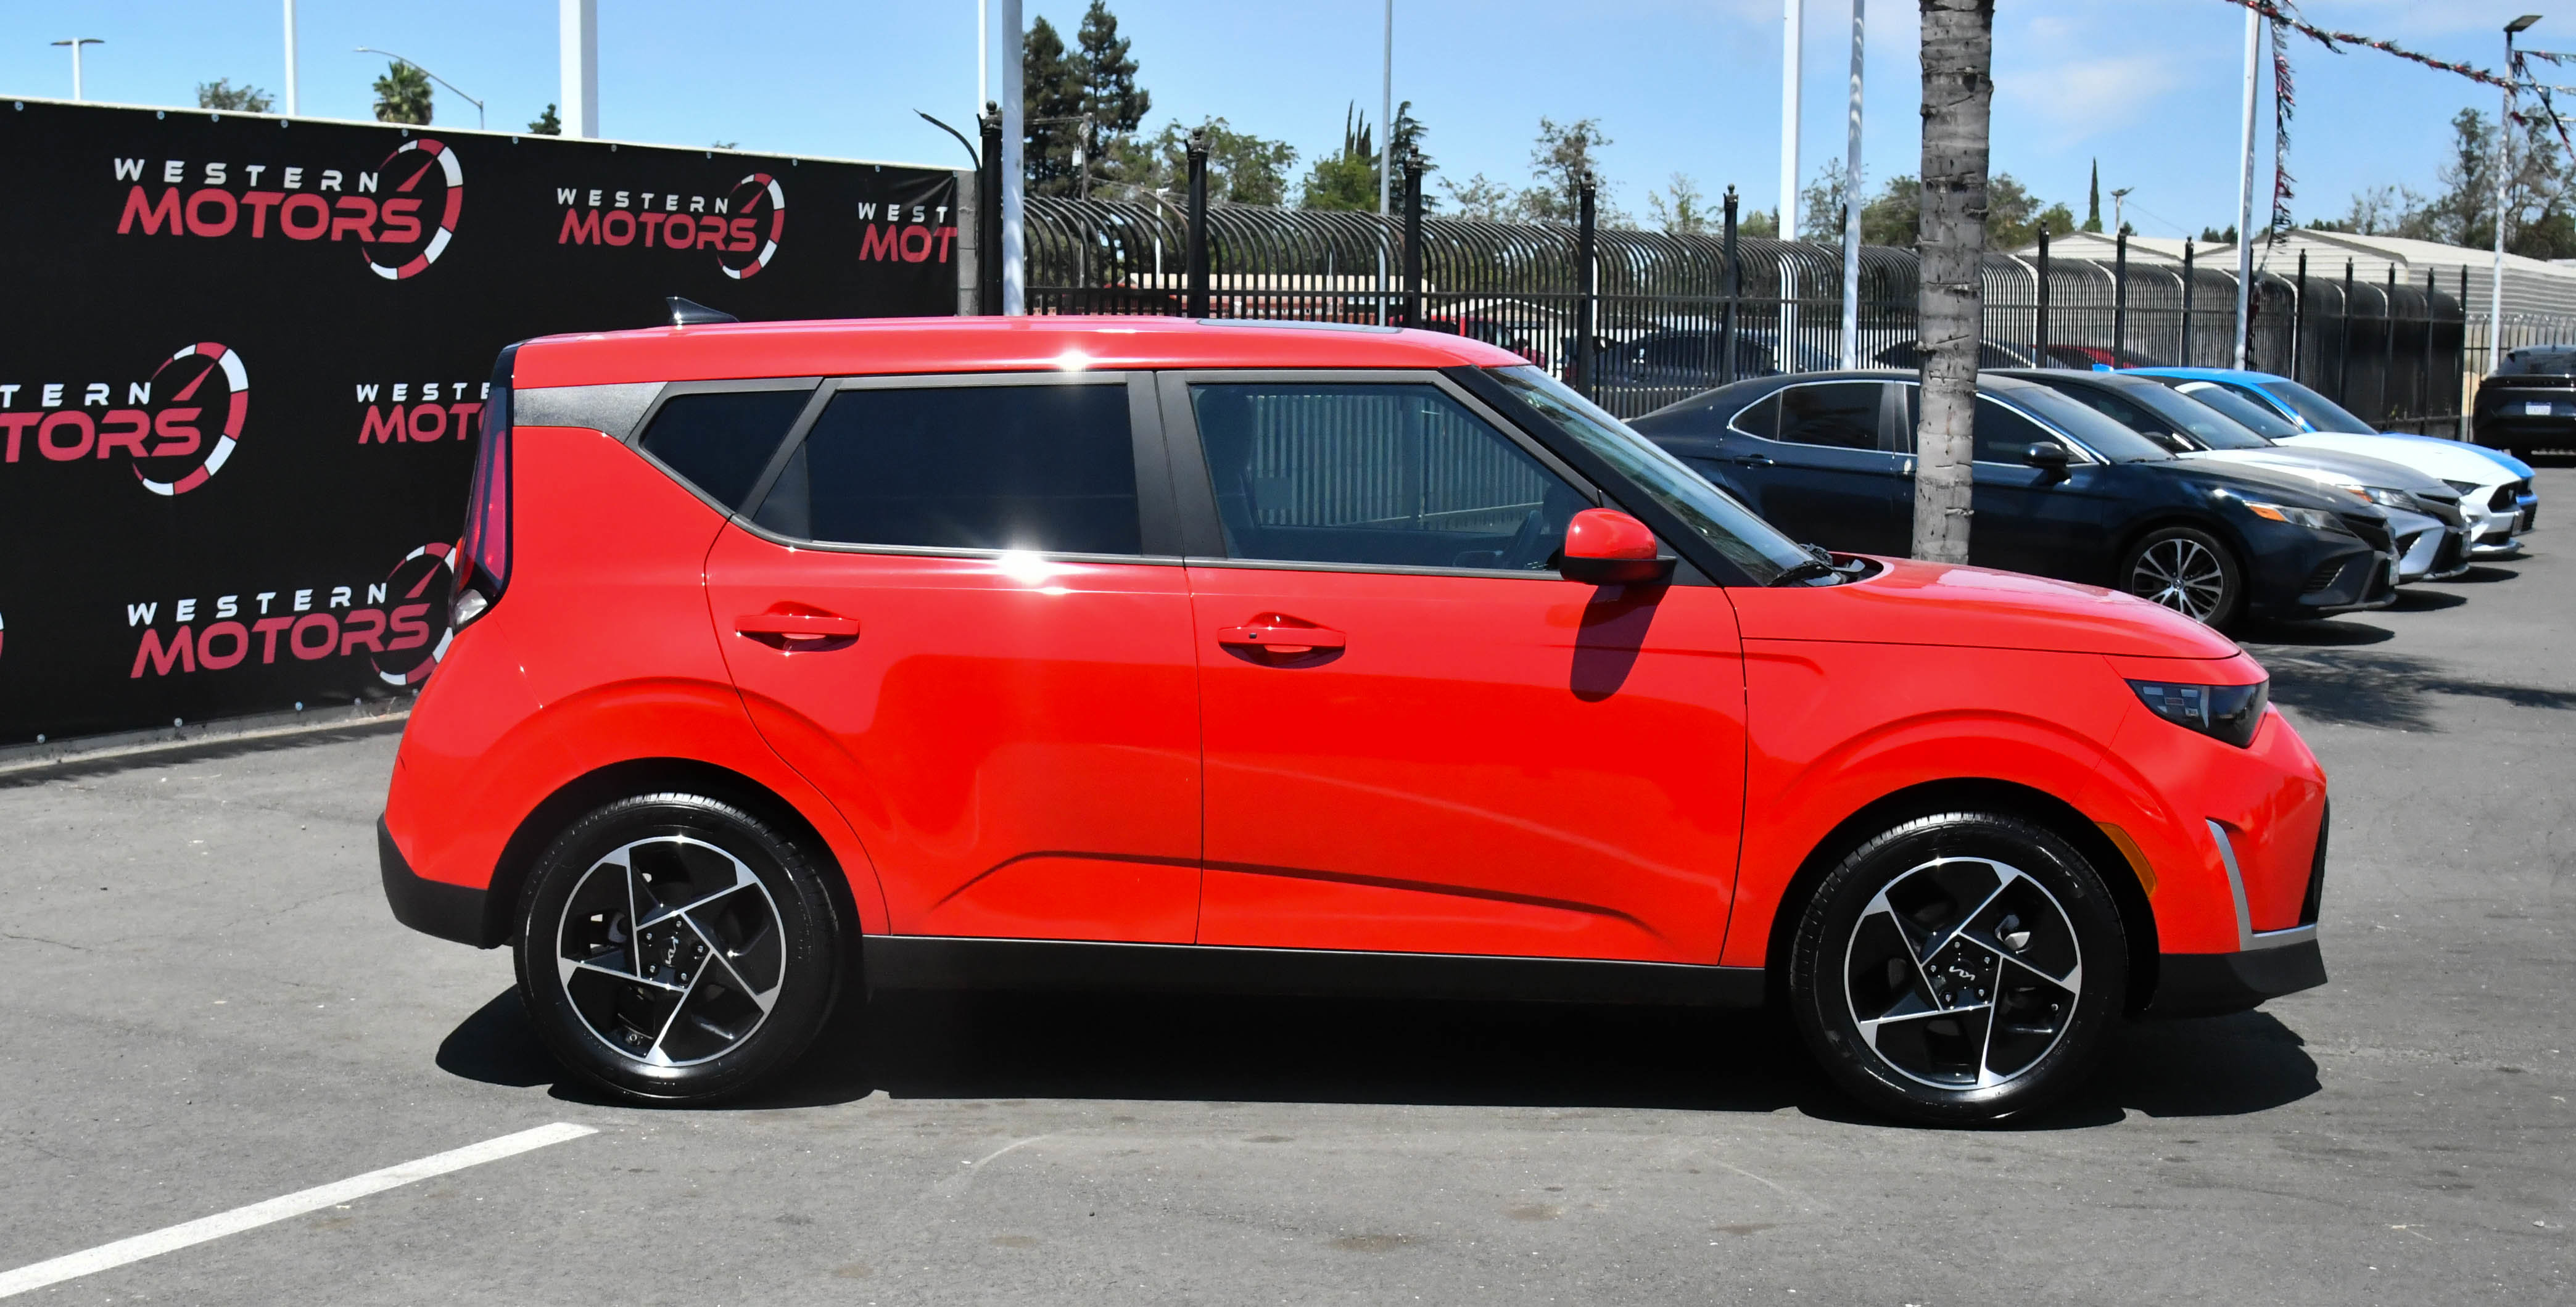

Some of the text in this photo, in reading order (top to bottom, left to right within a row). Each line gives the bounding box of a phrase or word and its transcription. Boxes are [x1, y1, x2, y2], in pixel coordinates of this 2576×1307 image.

[114, 158, 378, 193] WESTERN
[117, 185, 423, 243] MOTORS
[557, 188, 729, 214] WESTERN
[858, 202, 948, 223] WEST
[558, 208, 757, 252] MOTORS
[859, 223, 958, 263] MOT
[356, 382, 491, 403] WESTE
[358, 403, 485, 444] MOT
[127, 582, 387, 627] WESTERN
[130, 603, 431, 678] MOTORS
